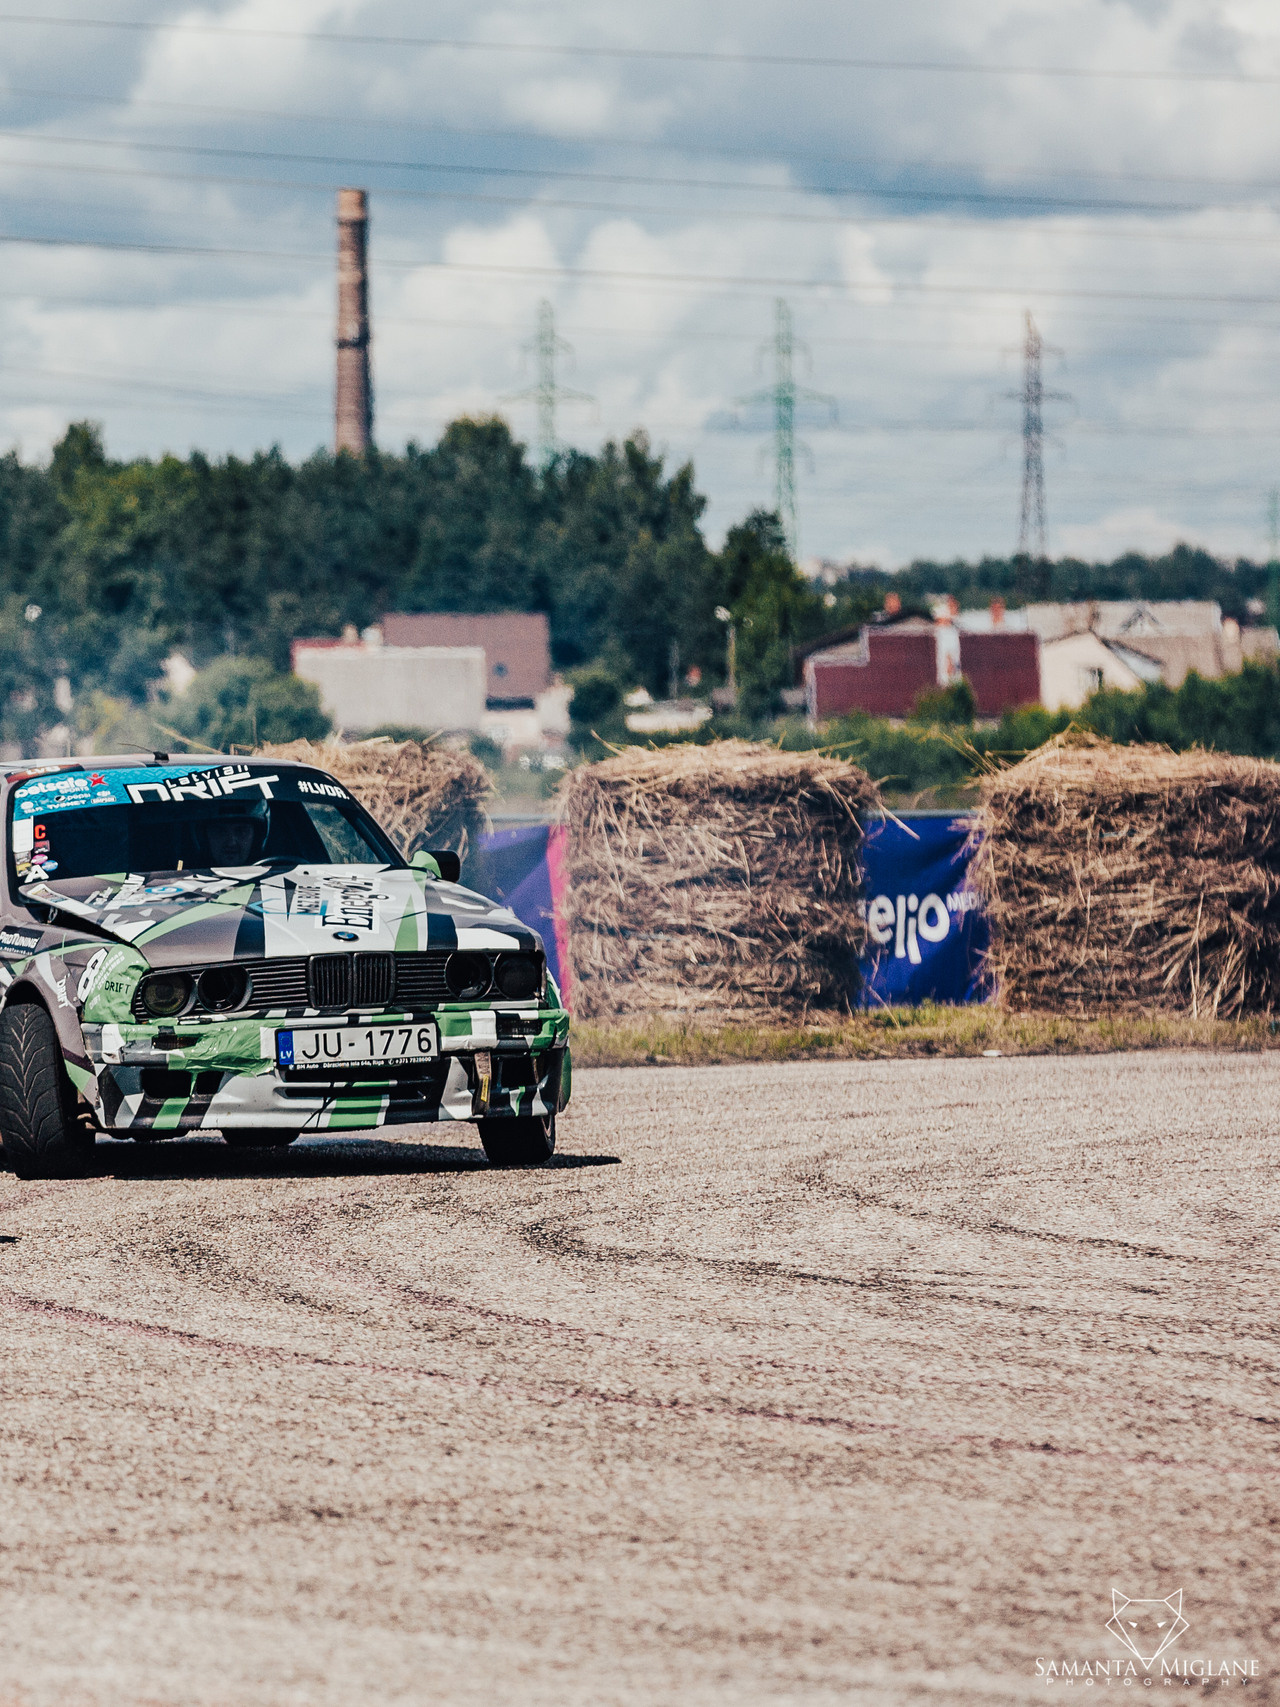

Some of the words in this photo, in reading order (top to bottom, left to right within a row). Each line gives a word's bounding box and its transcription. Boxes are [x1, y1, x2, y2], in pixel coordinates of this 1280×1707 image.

[126, 771, 280, 804] DRIFT
[104, 980, 132, 995] DRIFT
[280, 1051, 292, 1060] LV
